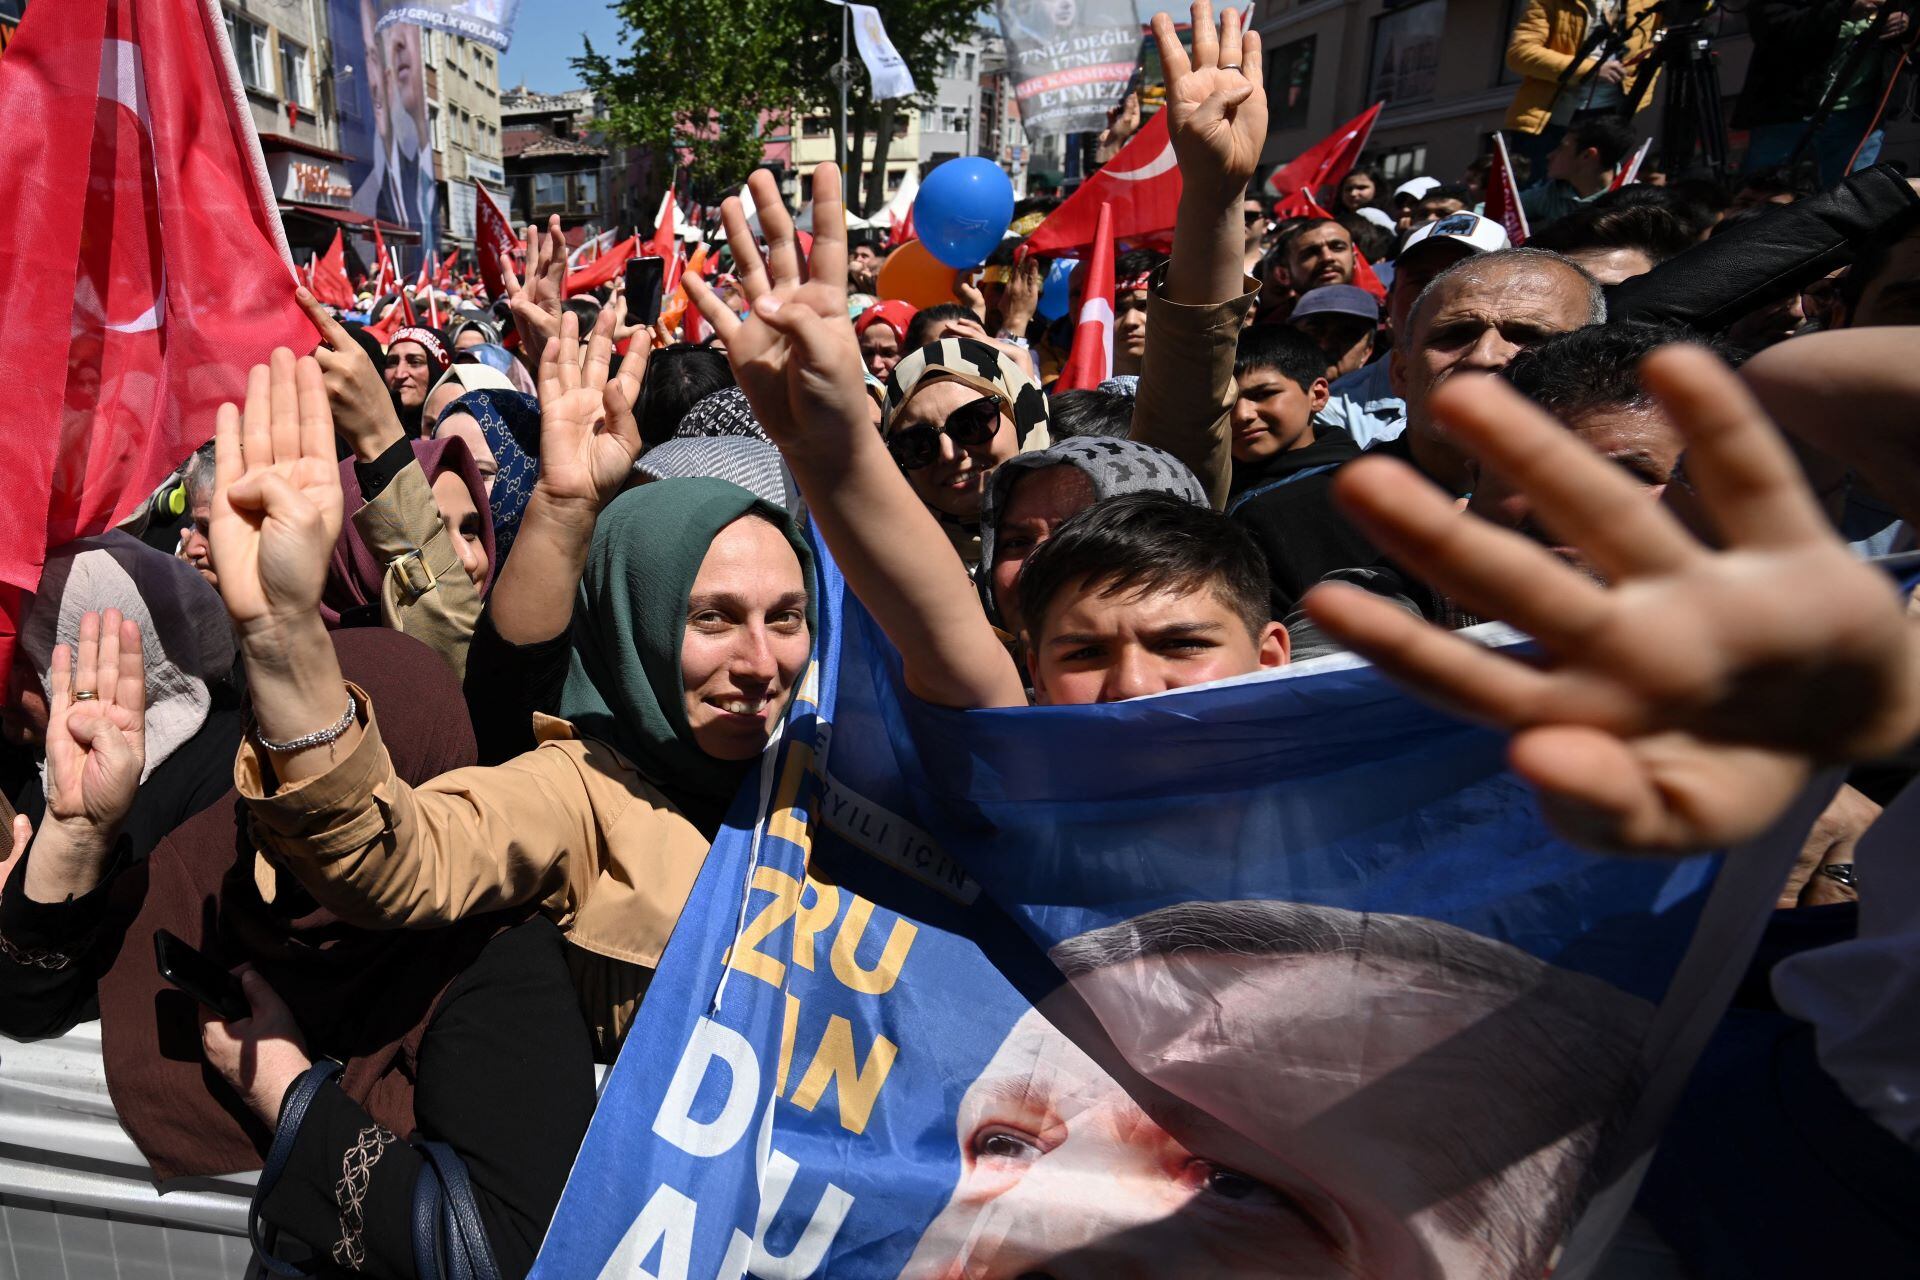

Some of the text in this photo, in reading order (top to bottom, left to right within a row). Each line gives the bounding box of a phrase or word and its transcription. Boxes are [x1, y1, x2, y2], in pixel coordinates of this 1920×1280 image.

[407, 8, 459, 27] GENÇLİK
[458, 19, 509, 46] KOLLARI
[1073, 29, 1136, 50] DEĞİL
[902, 836, 969, 891] İÇİN
